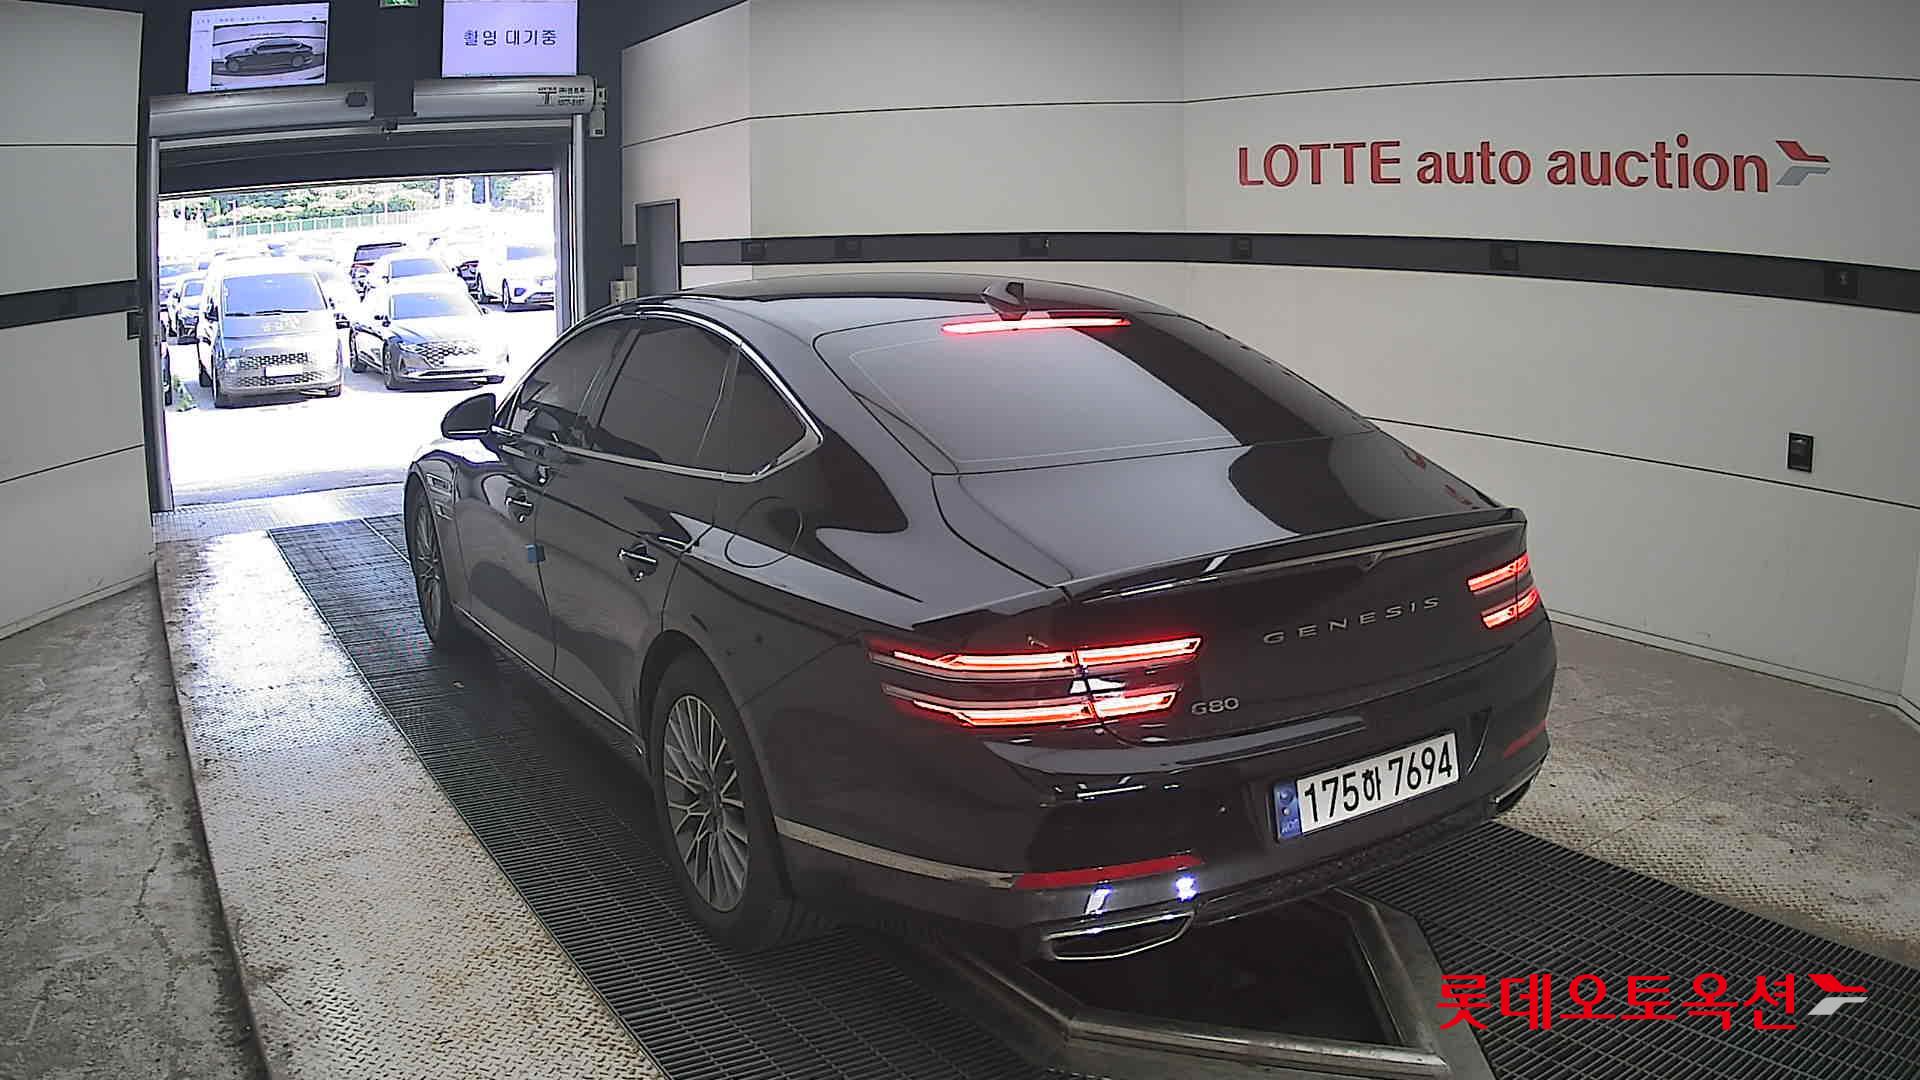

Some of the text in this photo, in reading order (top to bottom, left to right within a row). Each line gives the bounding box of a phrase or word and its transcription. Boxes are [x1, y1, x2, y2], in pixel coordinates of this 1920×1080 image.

[505, 30, 556, 46] 대기중
[1239, 133, 1769, 194] LOTTE auto auction
[1263, 597, 1440, 644] GENESIS
[1191, 697, 1240, 715] G80
[1304, 741, 1453, 823] 175하 7694
